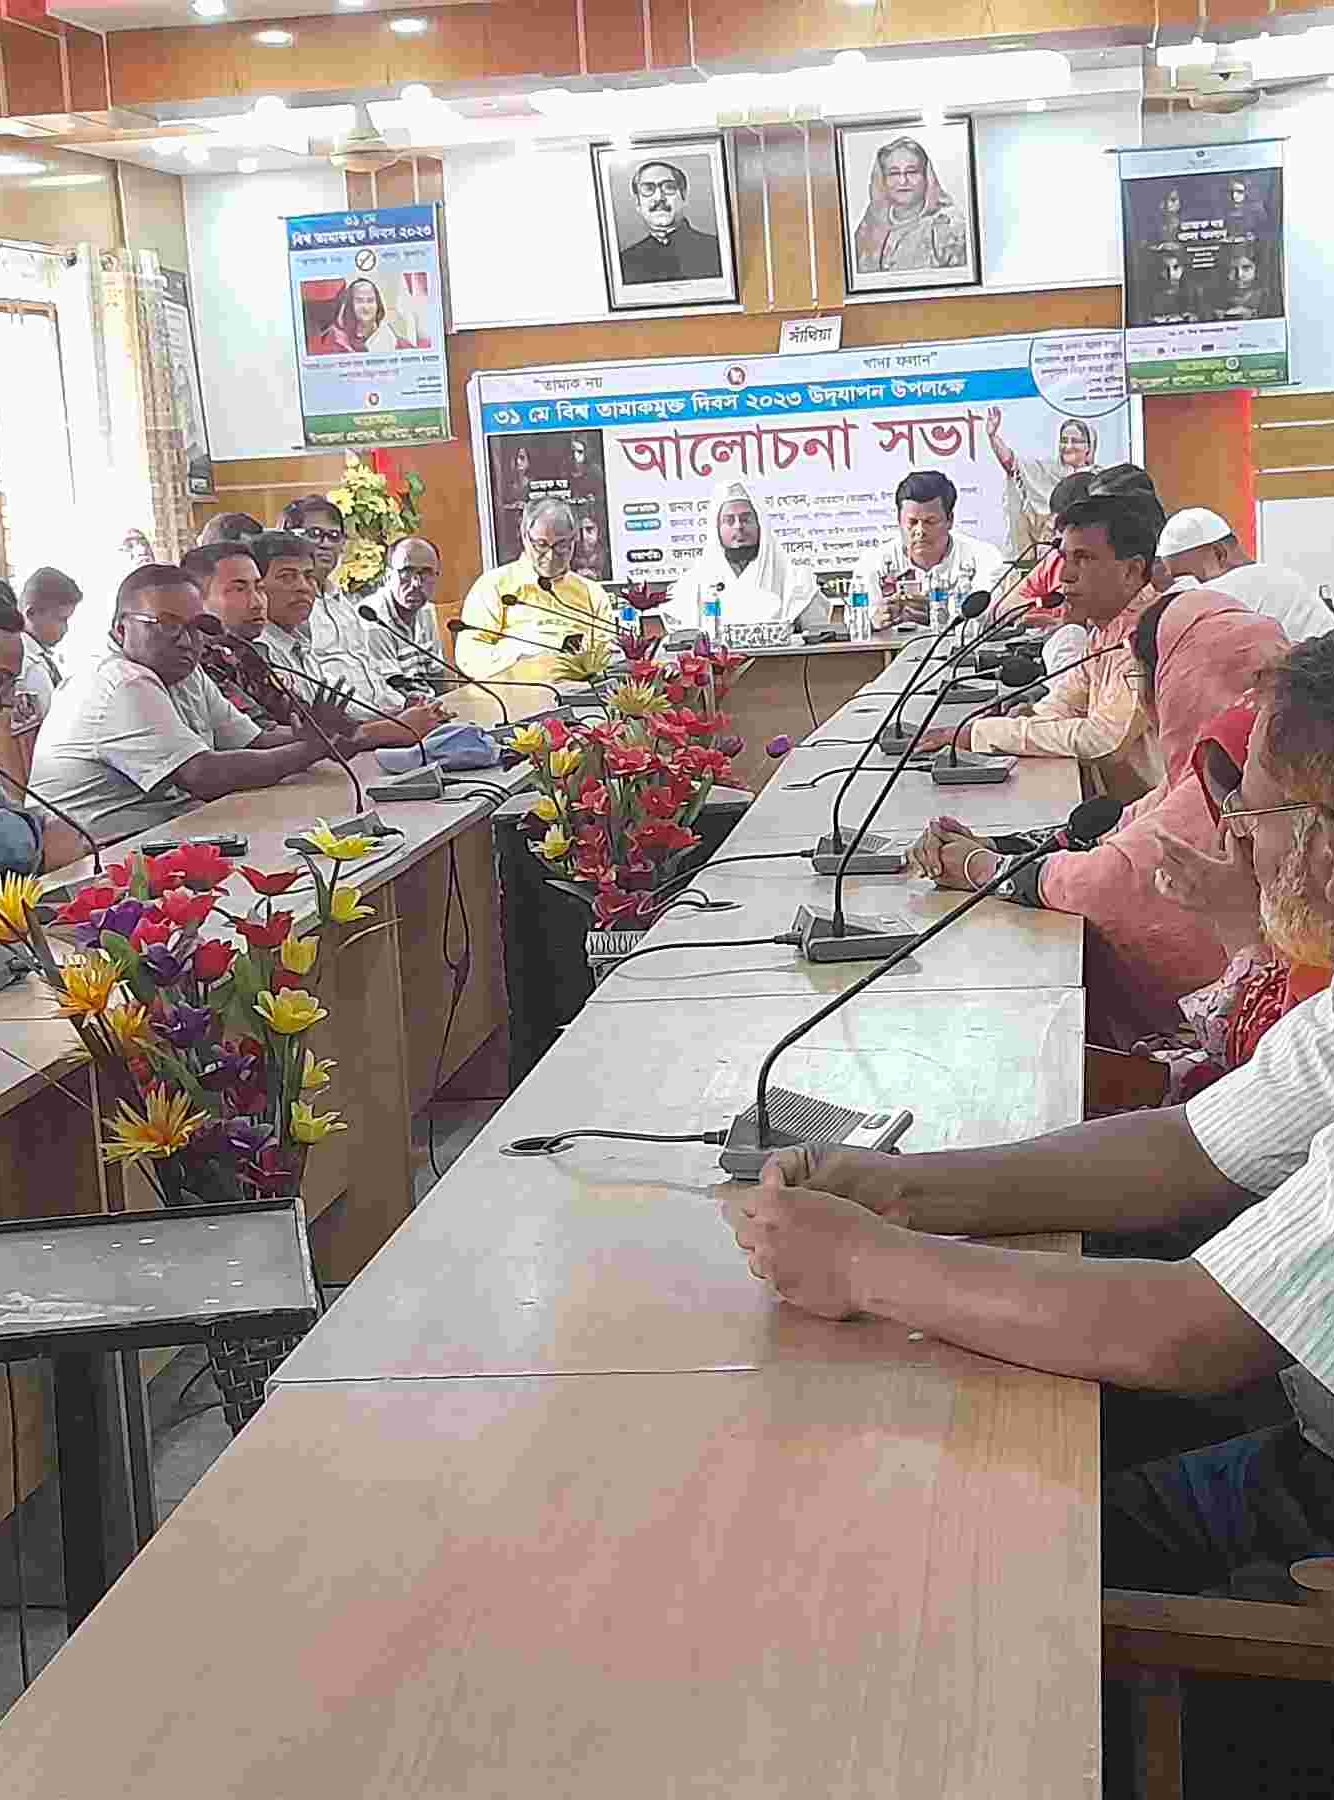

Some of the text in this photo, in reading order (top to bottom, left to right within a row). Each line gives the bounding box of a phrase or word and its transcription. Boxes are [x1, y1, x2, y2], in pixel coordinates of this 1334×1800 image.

[493, 410, 522, 425] ৩১
[529, 408, 550, 424] মে
[556, 399, 590, 421] বিশ্ব
[596, 400, 685, 420] তামাকমুক্ত
[691, 391, 740, 414] দিবস
[746, 393, 802, 410] ২০২৩
[890, 376, 968, 398] উপলক্ষে
[616, 408, 985, 480] আলোচনা সভা
